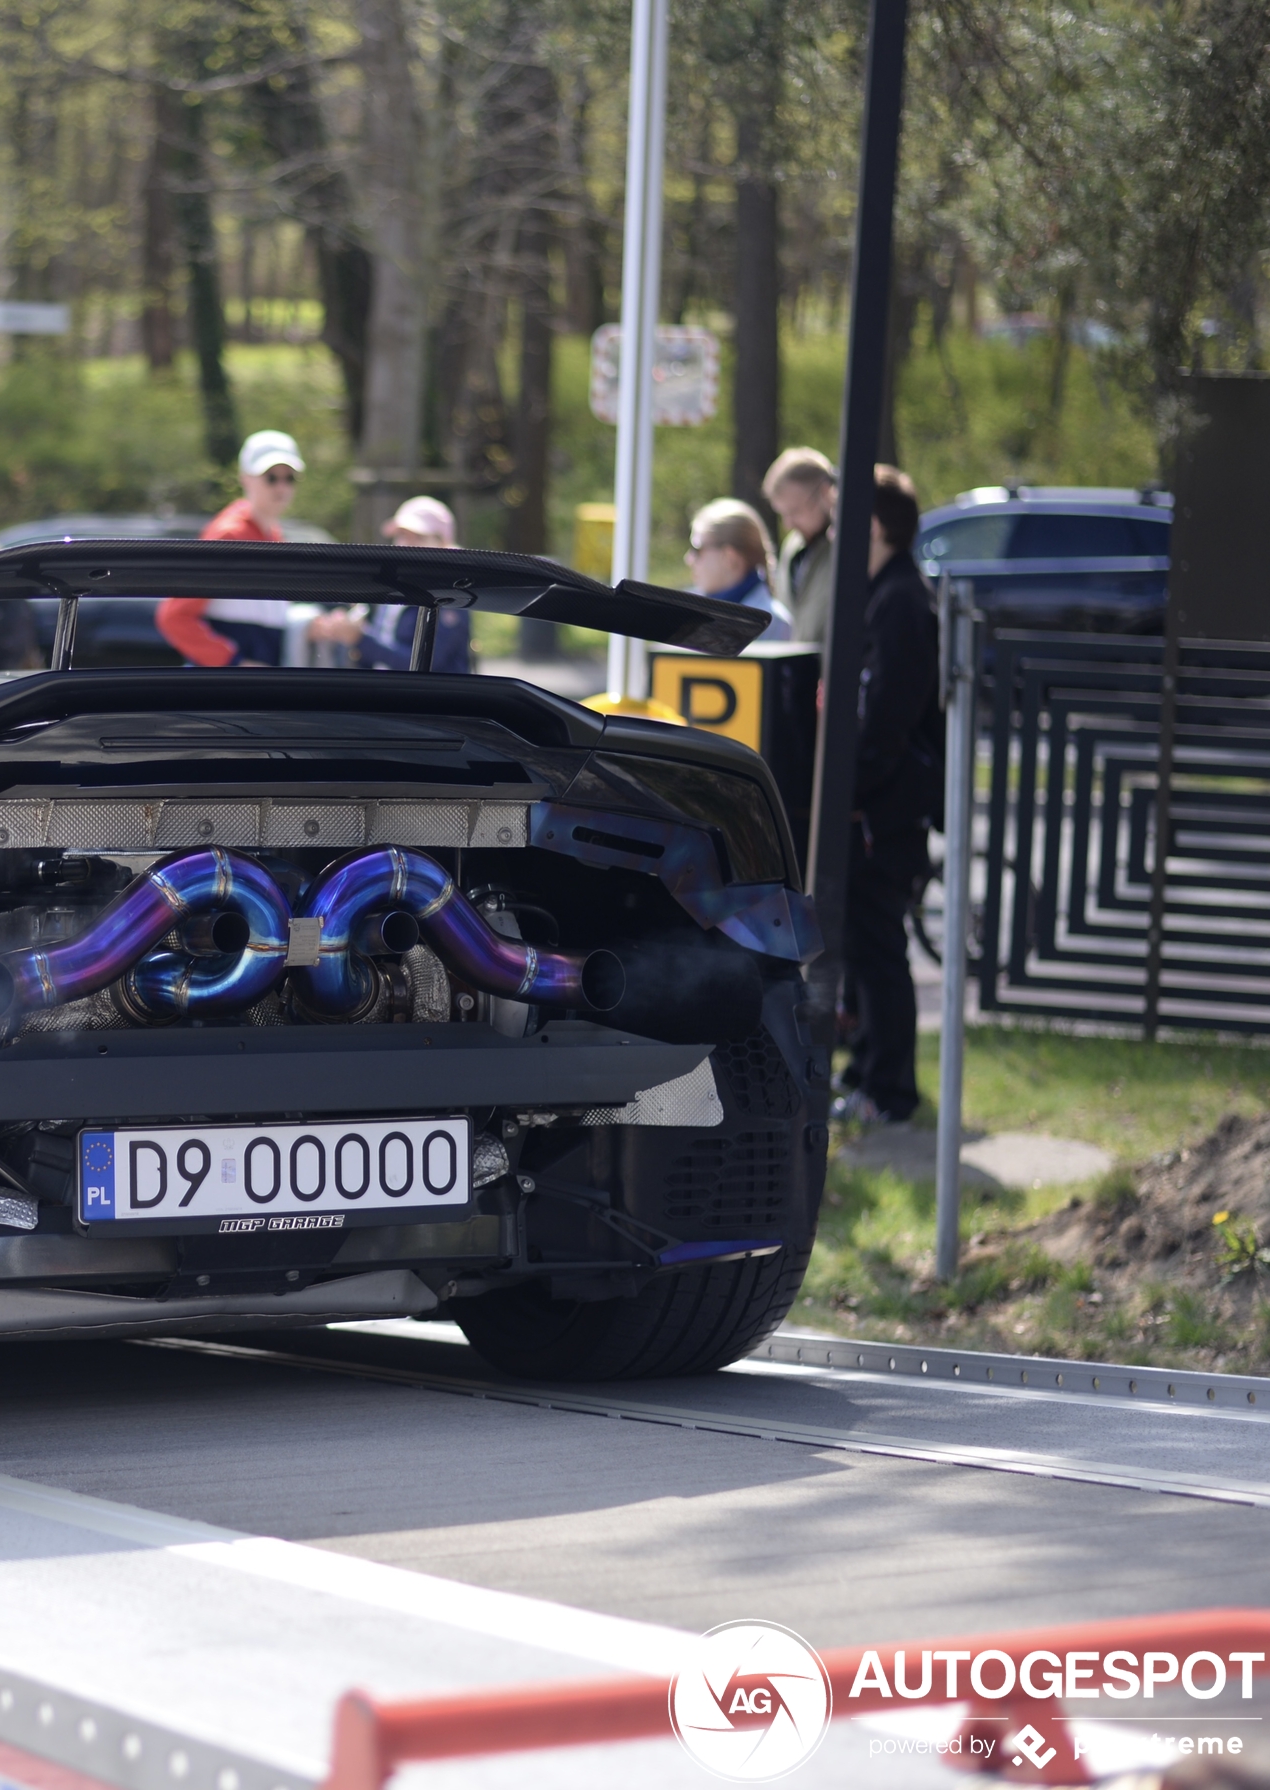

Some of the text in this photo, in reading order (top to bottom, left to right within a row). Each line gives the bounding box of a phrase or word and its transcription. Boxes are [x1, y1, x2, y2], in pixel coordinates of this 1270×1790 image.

[129, 1138, 211, 1209] D9
[87, 1187, 111, 1206] PL
[218, 1214, 345, 1233] MGP GARAGE
